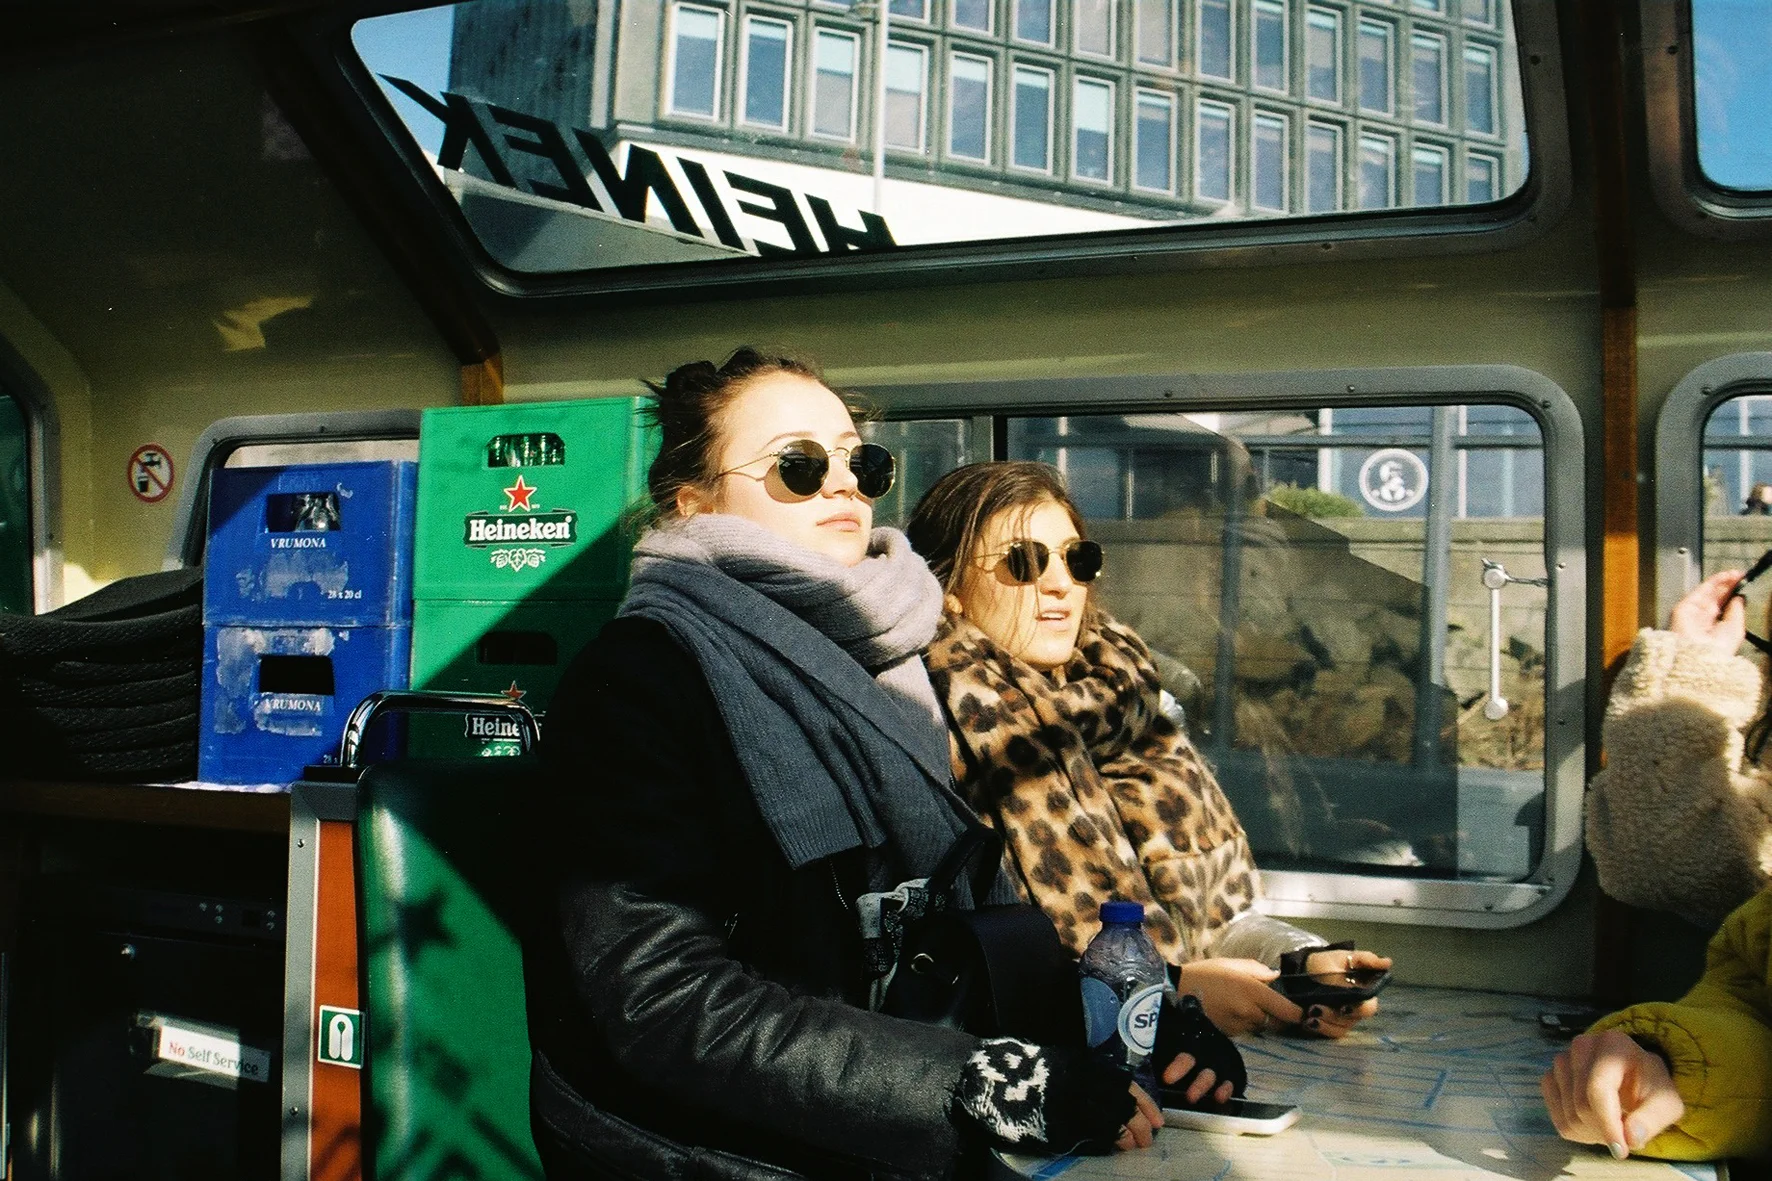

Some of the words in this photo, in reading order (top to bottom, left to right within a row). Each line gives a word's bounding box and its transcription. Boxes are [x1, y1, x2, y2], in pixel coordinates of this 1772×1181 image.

[469, 517, 572, 541] Heineken
[271, 538, 326, 549] VRUMONA
[327, 590, 337, 600] 28
[344, 589, 354, 600] 20
[264, 699, 321, 711] VRUMONA
[1134, 1012, 1158, 1028] SP
[169, 1041, 185, 1057] No
[187, 1046, 212, 1064] Self
[213, 1051, 259, 1076] Service
